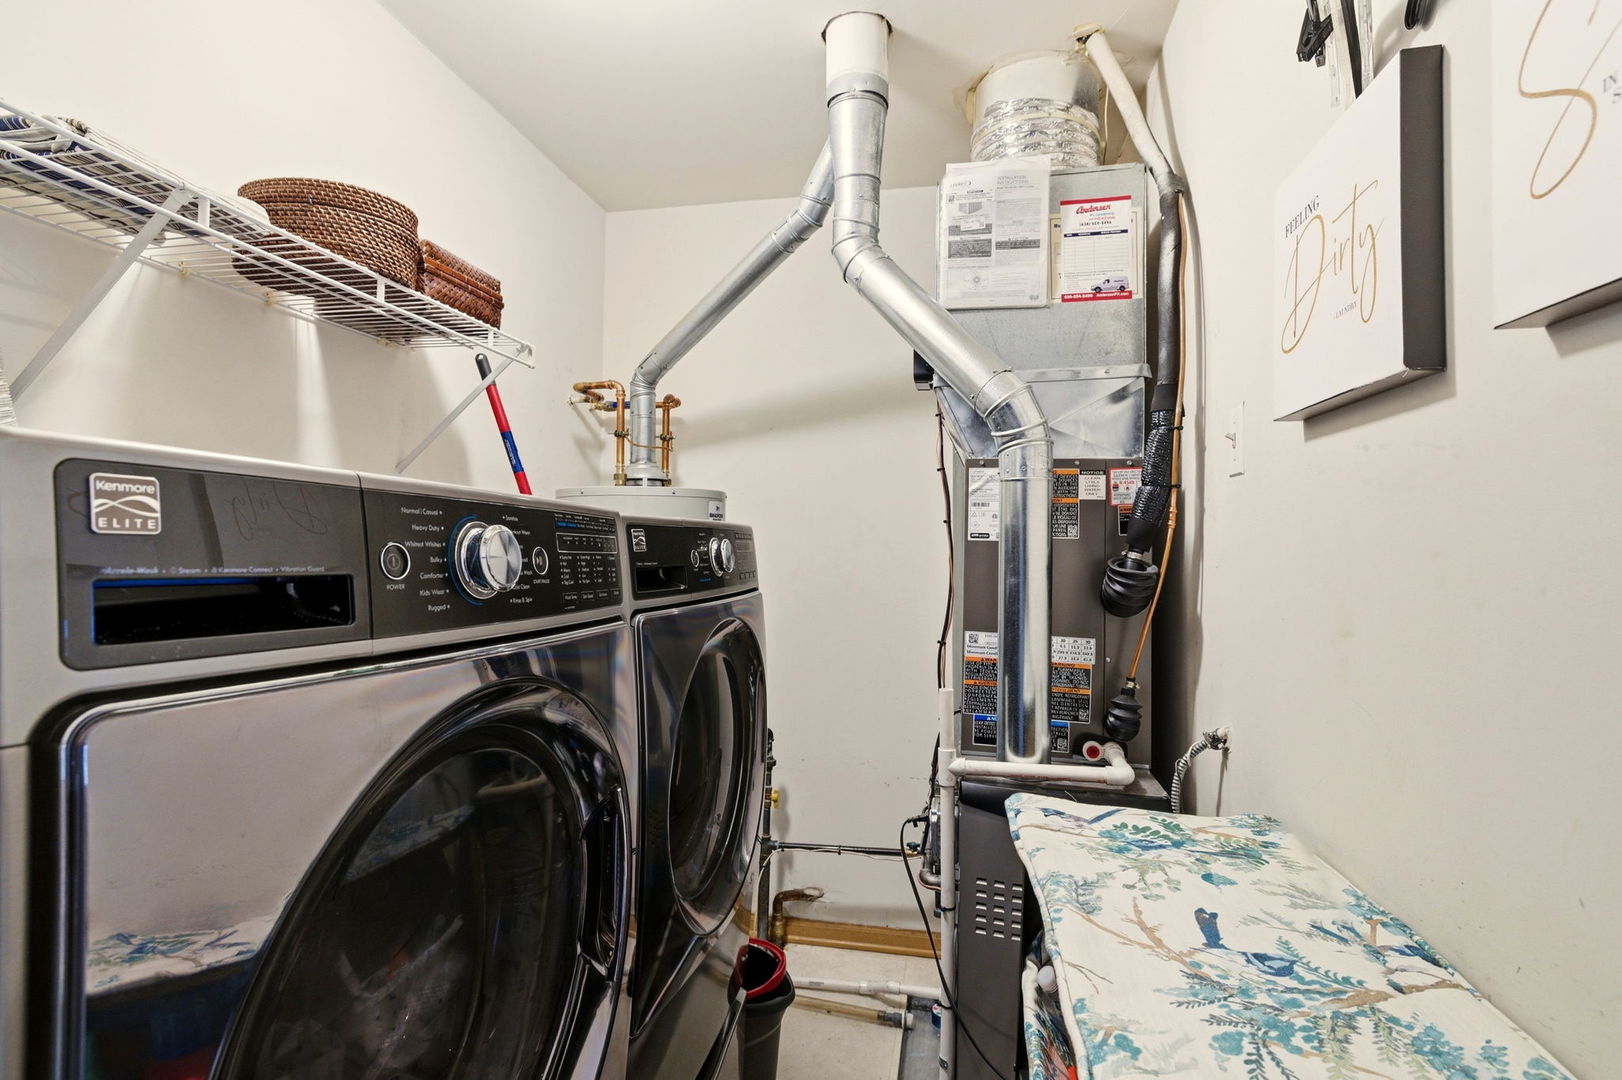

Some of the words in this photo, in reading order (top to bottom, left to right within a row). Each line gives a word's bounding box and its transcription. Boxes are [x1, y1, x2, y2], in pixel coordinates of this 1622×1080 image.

[1284, 194, 1321, 239] FEELING
[1281, 179, 1385, 354] Dirty
[96, 479, 156, 495] Kenmore
[98, 517, 157, 530] ELITE
[386, 583, 405, 591] POWER
